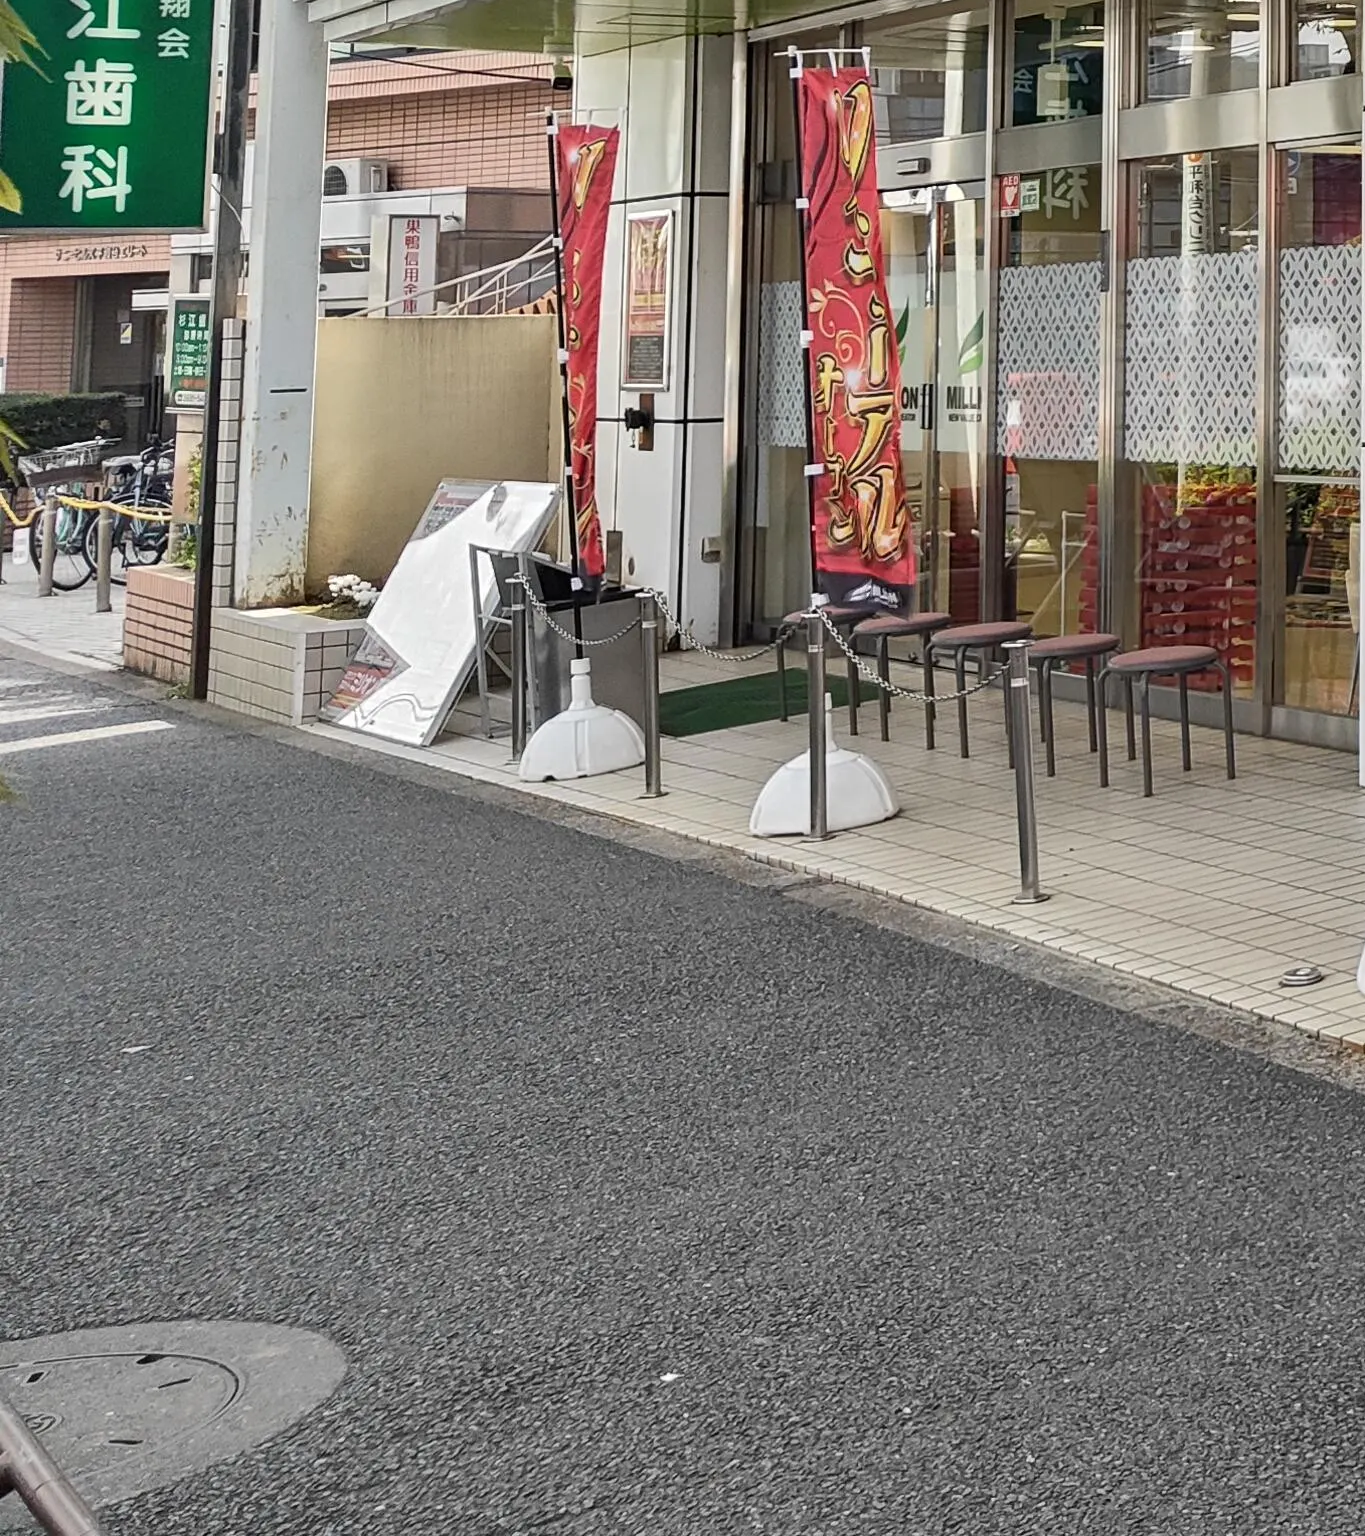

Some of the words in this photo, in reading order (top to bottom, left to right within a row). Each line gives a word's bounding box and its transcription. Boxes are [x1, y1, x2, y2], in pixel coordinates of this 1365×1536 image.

[1003, 175, 1019, 186] AED
[403, 219, 421, 315] 巣鴨信用金庫
[946, 386, 982, 410] MILLI
